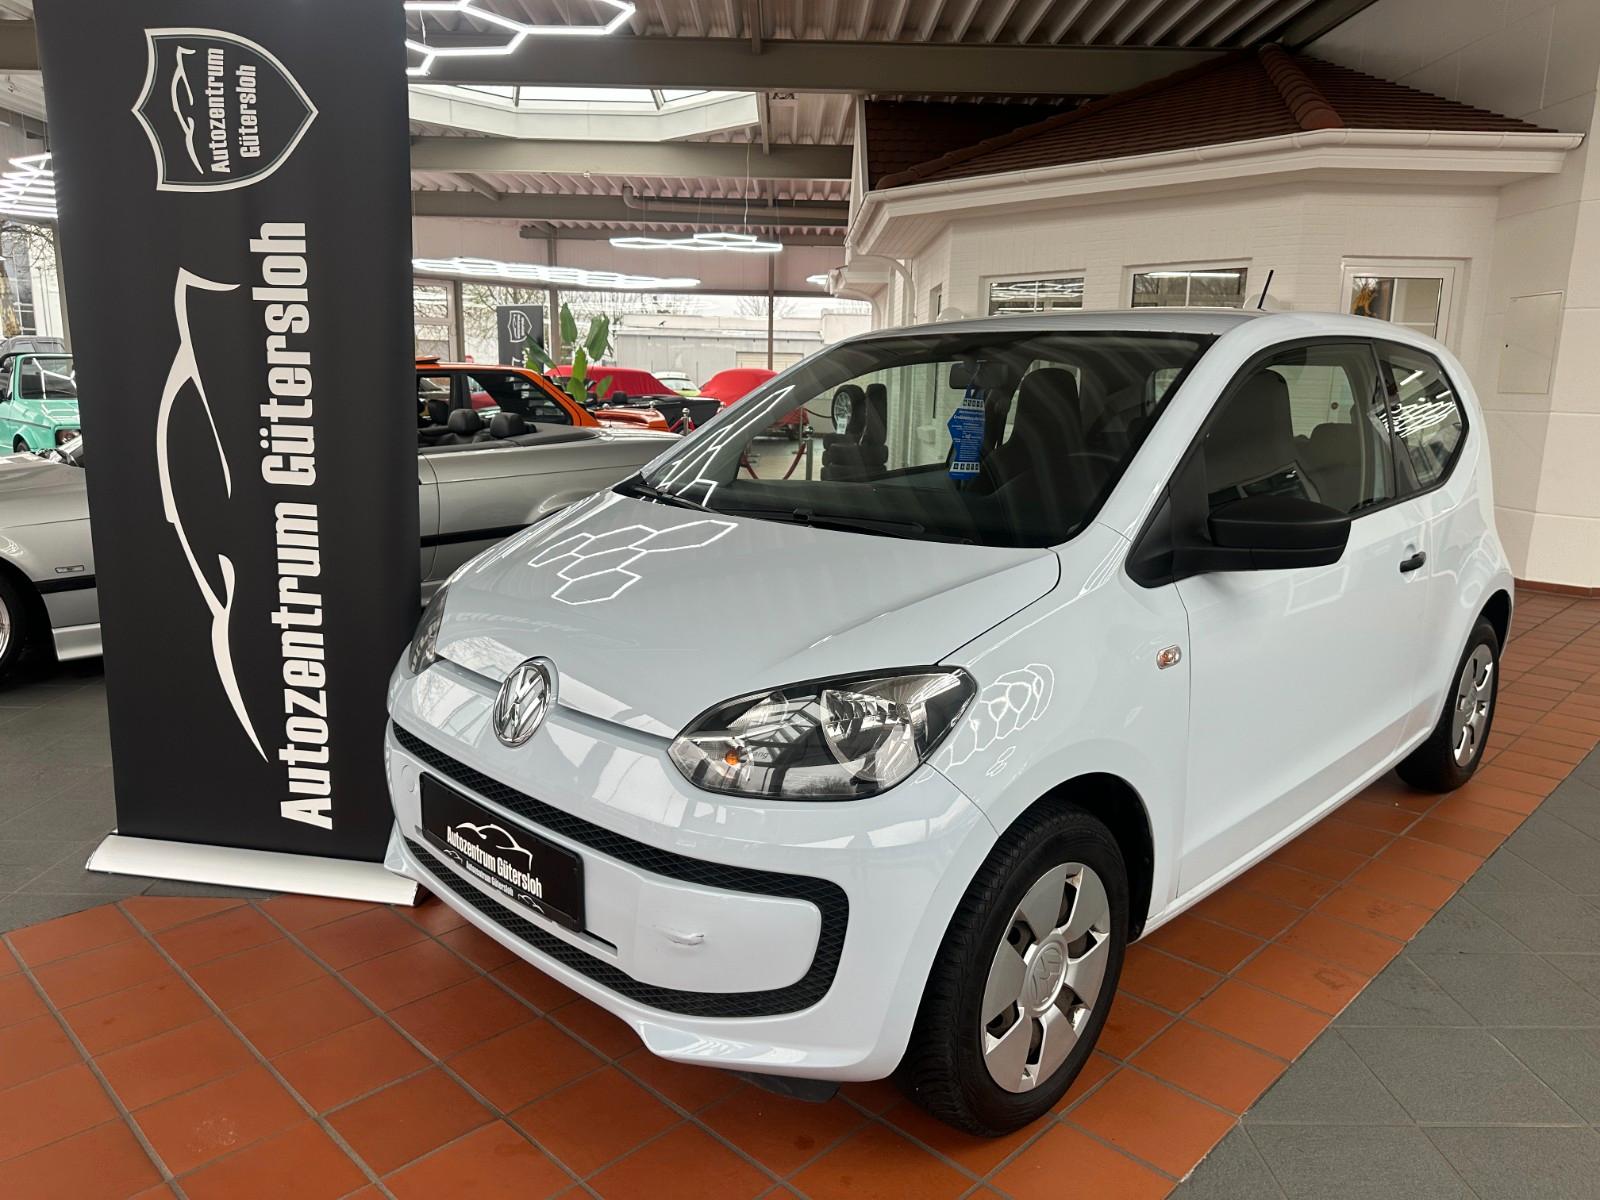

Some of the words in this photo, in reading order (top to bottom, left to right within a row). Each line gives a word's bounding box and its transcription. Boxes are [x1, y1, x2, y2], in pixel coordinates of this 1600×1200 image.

[205, 48, 231, 173] Autozentrum
[235, 64, 260, 158] Gütersloh
[249, 222, 317, 486] Gütersloh
[271, 502, 333, 830] Autozentrum
[446, 825, 496, 873] Autozentrum
[496, 856, 543, 899] Gütersloh
